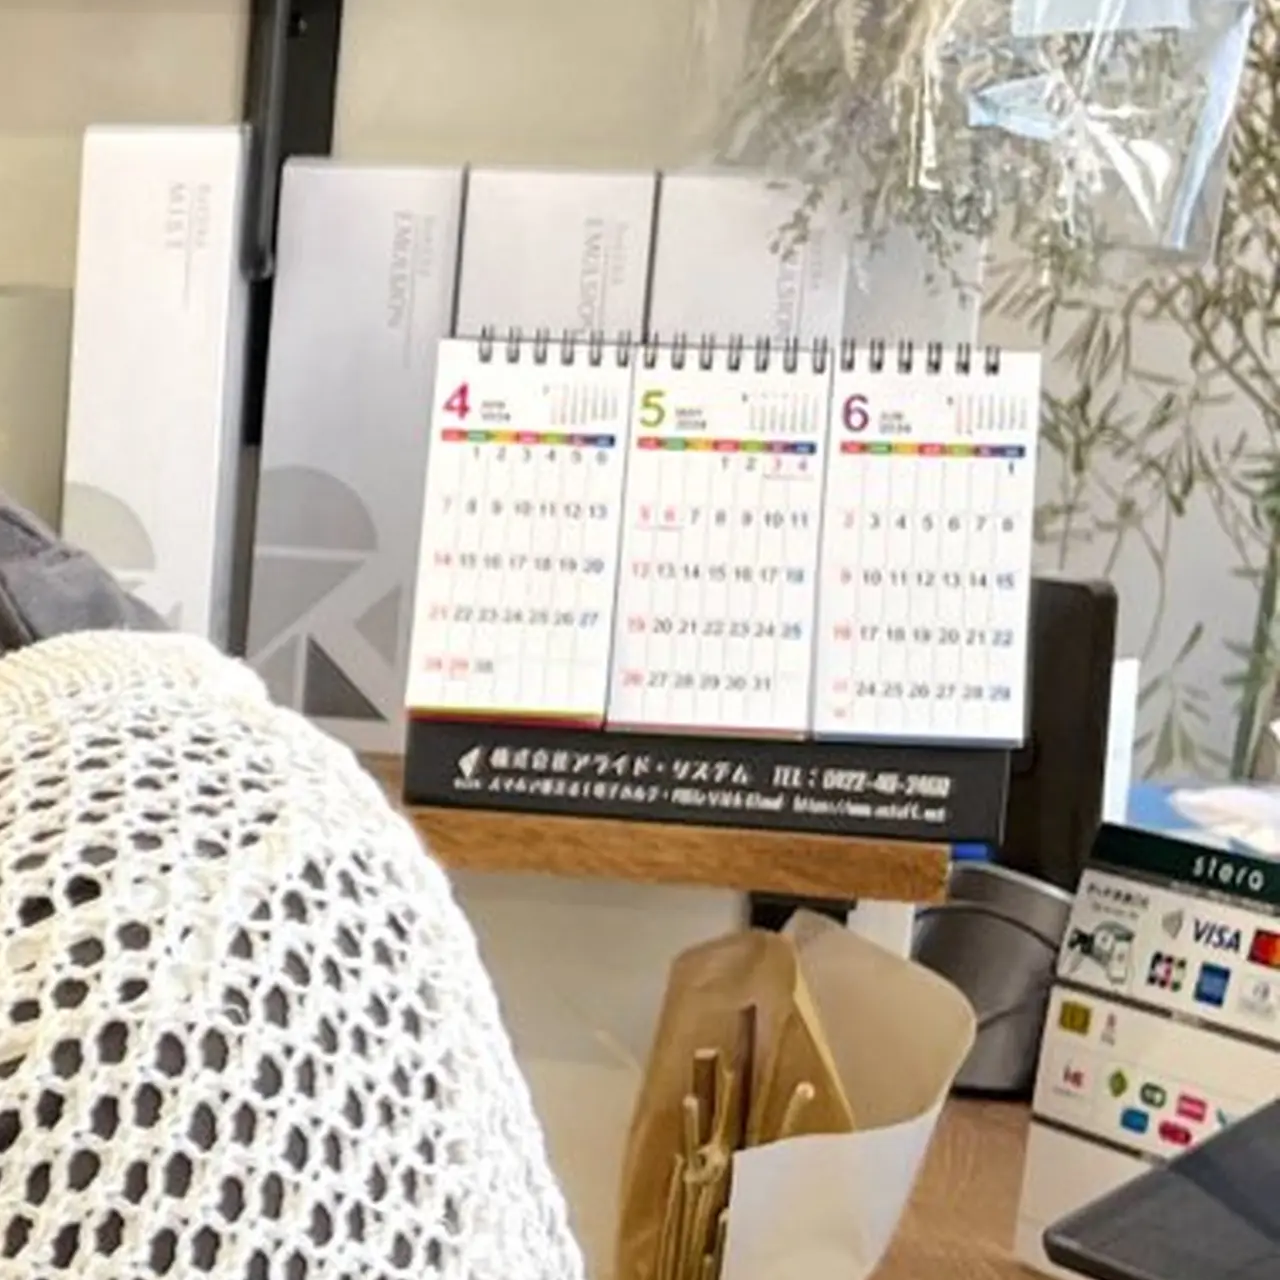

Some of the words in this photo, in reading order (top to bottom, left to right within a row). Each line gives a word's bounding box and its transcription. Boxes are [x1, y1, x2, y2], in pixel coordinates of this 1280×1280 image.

[442, 381, 471, 420] 4
[640, 389, 666, 427] 5
[842, 393, 870, 432] 6
[1194, 856, 1265, 892] stera
[1194, 918, 1243, 954] VISA
